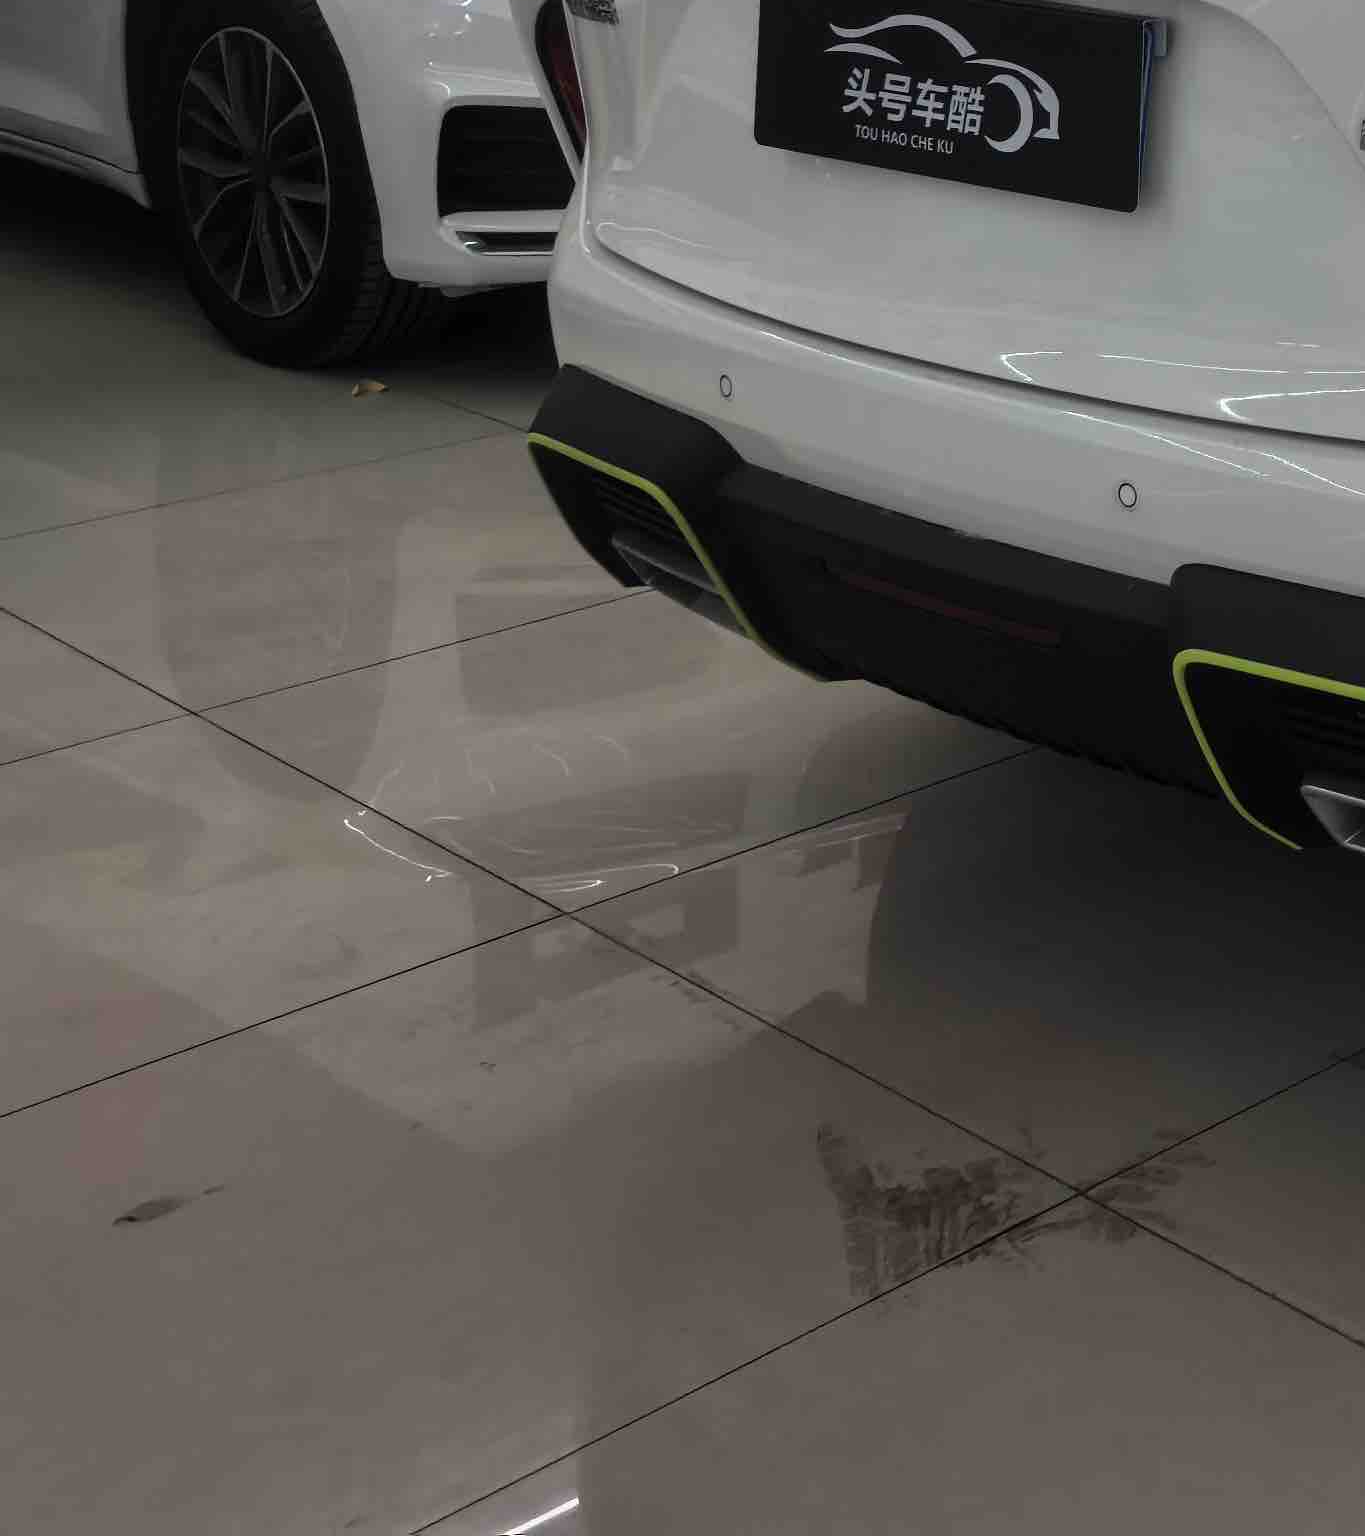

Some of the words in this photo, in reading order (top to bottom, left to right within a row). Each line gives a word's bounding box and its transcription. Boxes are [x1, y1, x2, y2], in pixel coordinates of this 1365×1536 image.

[841, 67, 986, 136] 头号车酷
[855, 124, 878, 141] TOU
[881, 129, 908, 146] HAO
[910, 134, 934, 152] CHE
[936, 139, 954, 154] KU
